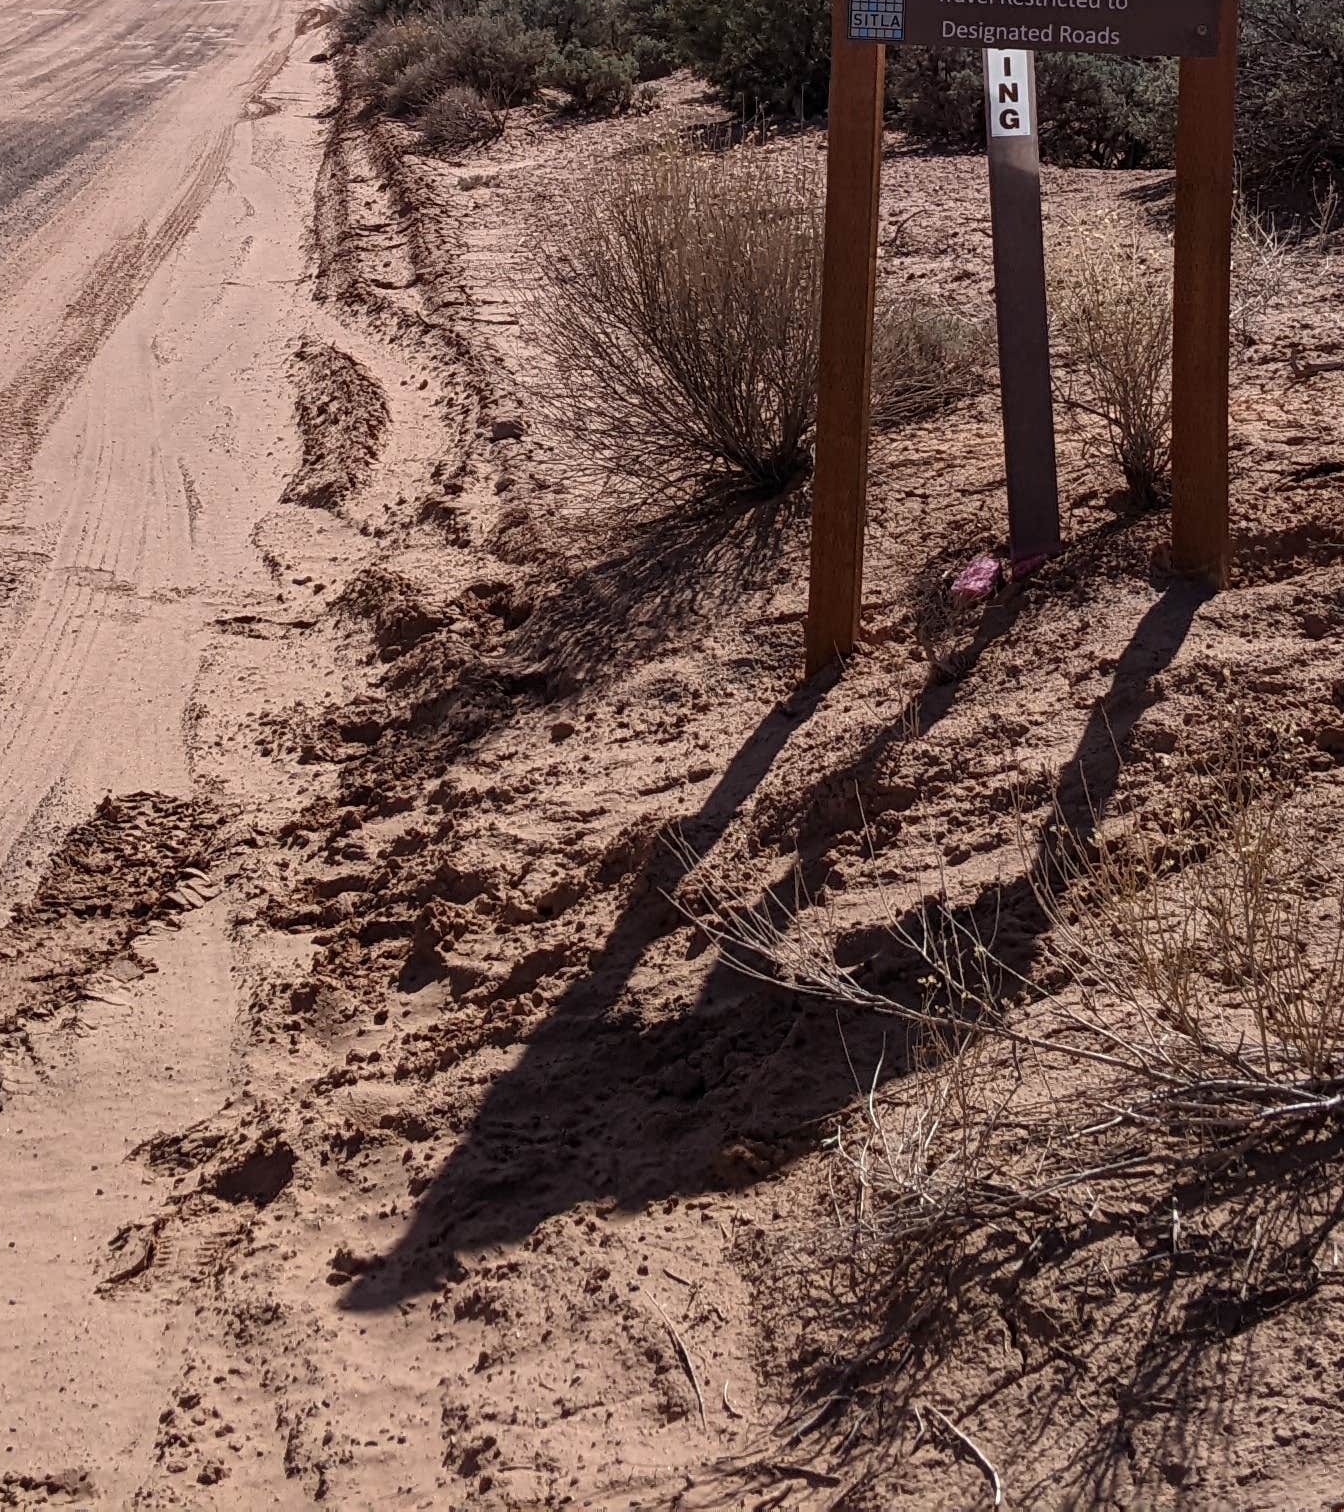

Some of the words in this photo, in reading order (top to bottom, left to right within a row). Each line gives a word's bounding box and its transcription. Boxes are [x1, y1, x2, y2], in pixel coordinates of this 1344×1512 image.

[853, 13, 900, 27] SITLA
[943, 21, 1052, 43] Designated
[1060, 26, 1119, 44] Roads
[998, 49, 1020, 130] ING
